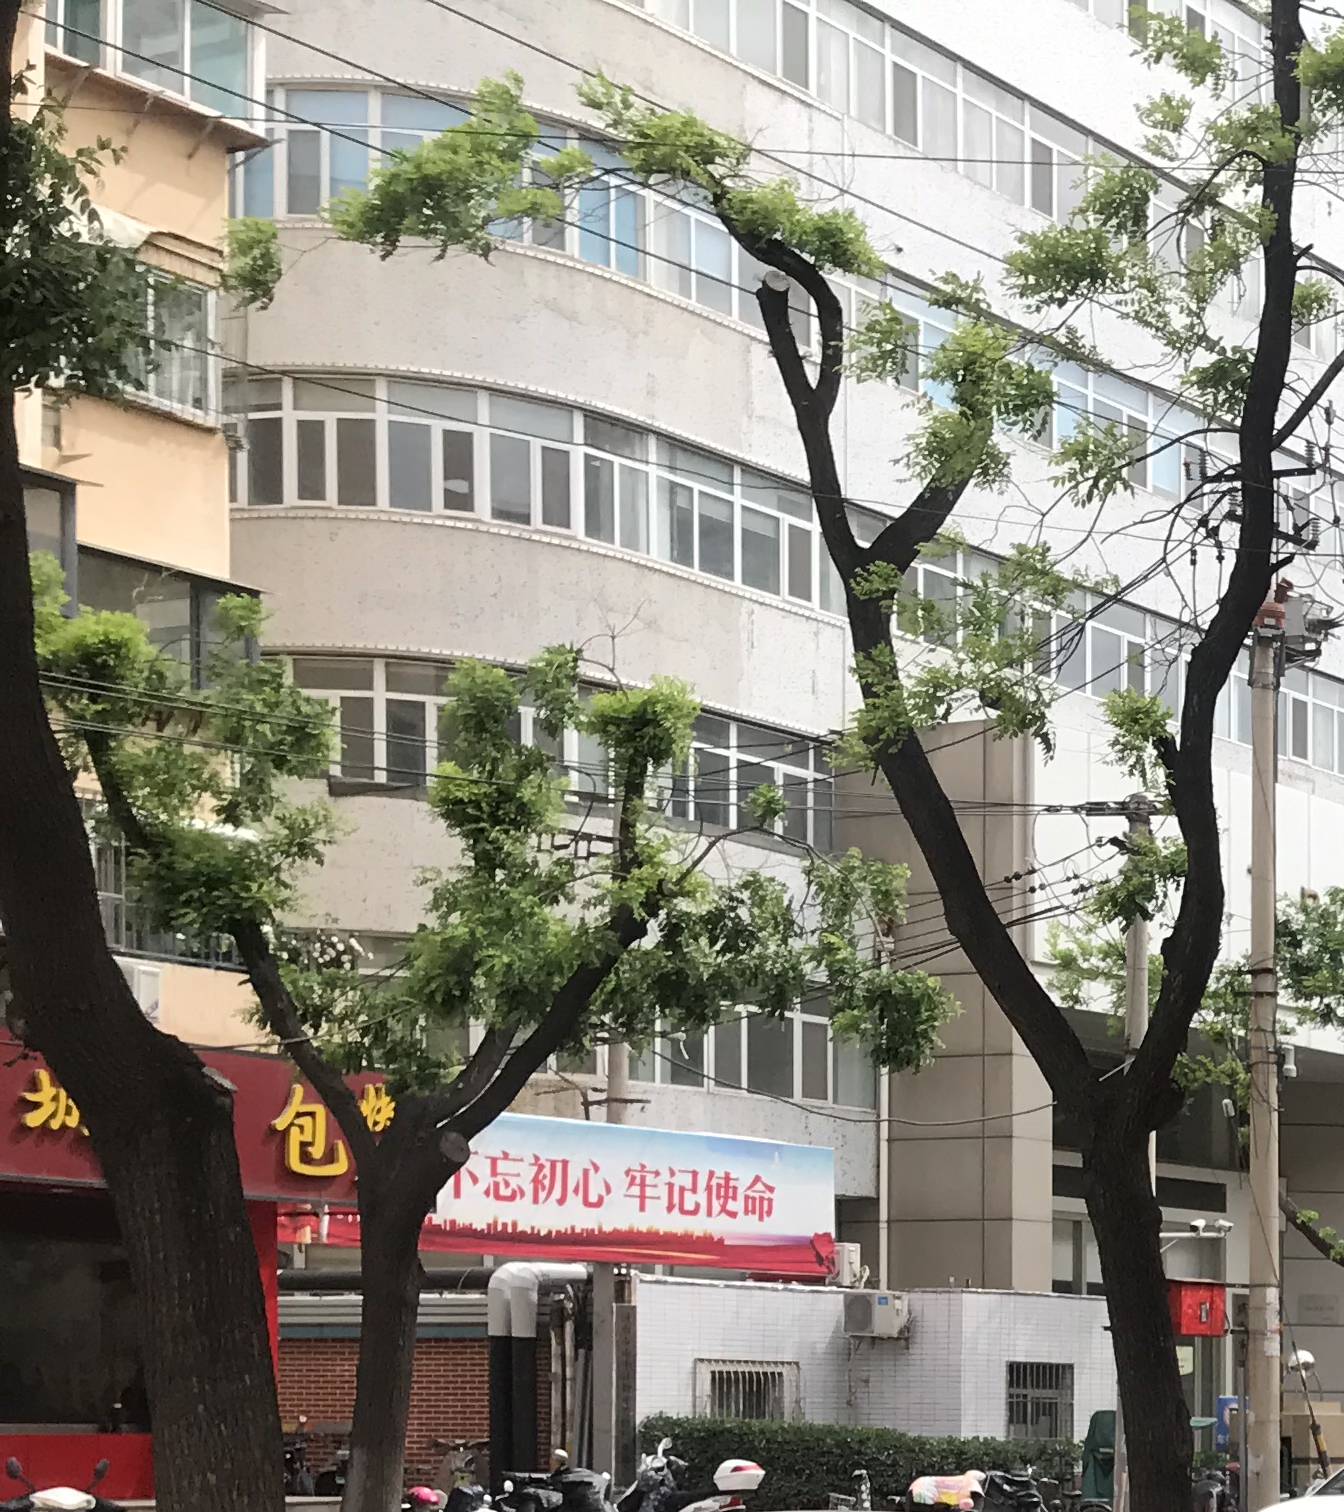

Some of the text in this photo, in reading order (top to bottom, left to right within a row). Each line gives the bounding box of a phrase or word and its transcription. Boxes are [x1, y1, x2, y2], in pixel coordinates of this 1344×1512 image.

[272, 1084, 349, 1177] 包
[451, 1151, 777, 1223] 不忘初心 牢记使命
